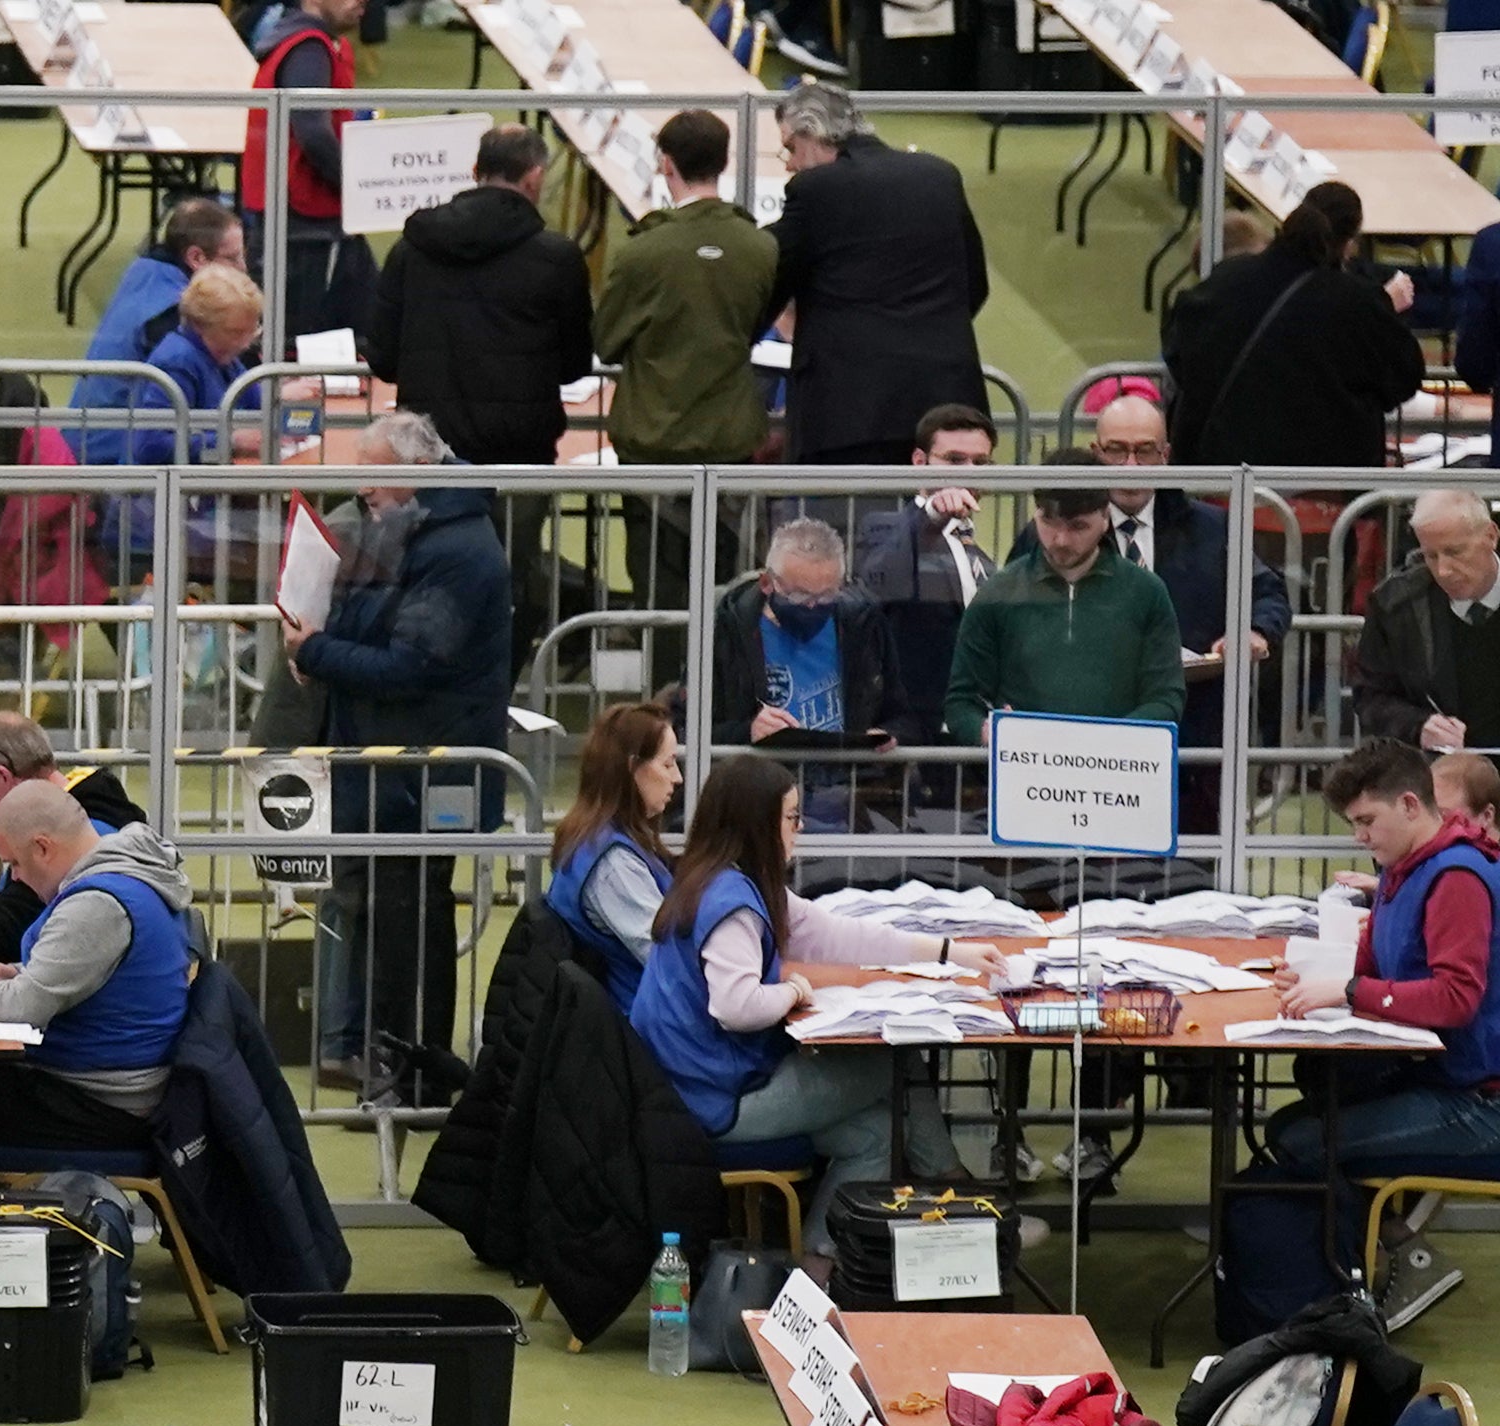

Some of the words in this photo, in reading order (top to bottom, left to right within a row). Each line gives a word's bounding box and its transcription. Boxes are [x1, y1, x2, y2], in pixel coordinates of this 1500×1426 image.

[392, 151, 448, 168] FOYLE
[1000, 751, 1039, 764] EAST
[1044, 754, 1160, 773] LONDONDERRY
[1027, 787, 1087, 804] COUNT
[1093, 792, 1140, 807] TEAM
[1072, 814, 1088, 827] 13
[253, 855, 277, 872] No
[282, 858, 324, 878] entry
[939, 1275, 978, 1285] 27/ELY
[773, 1294, 817, 1348] STEWART
